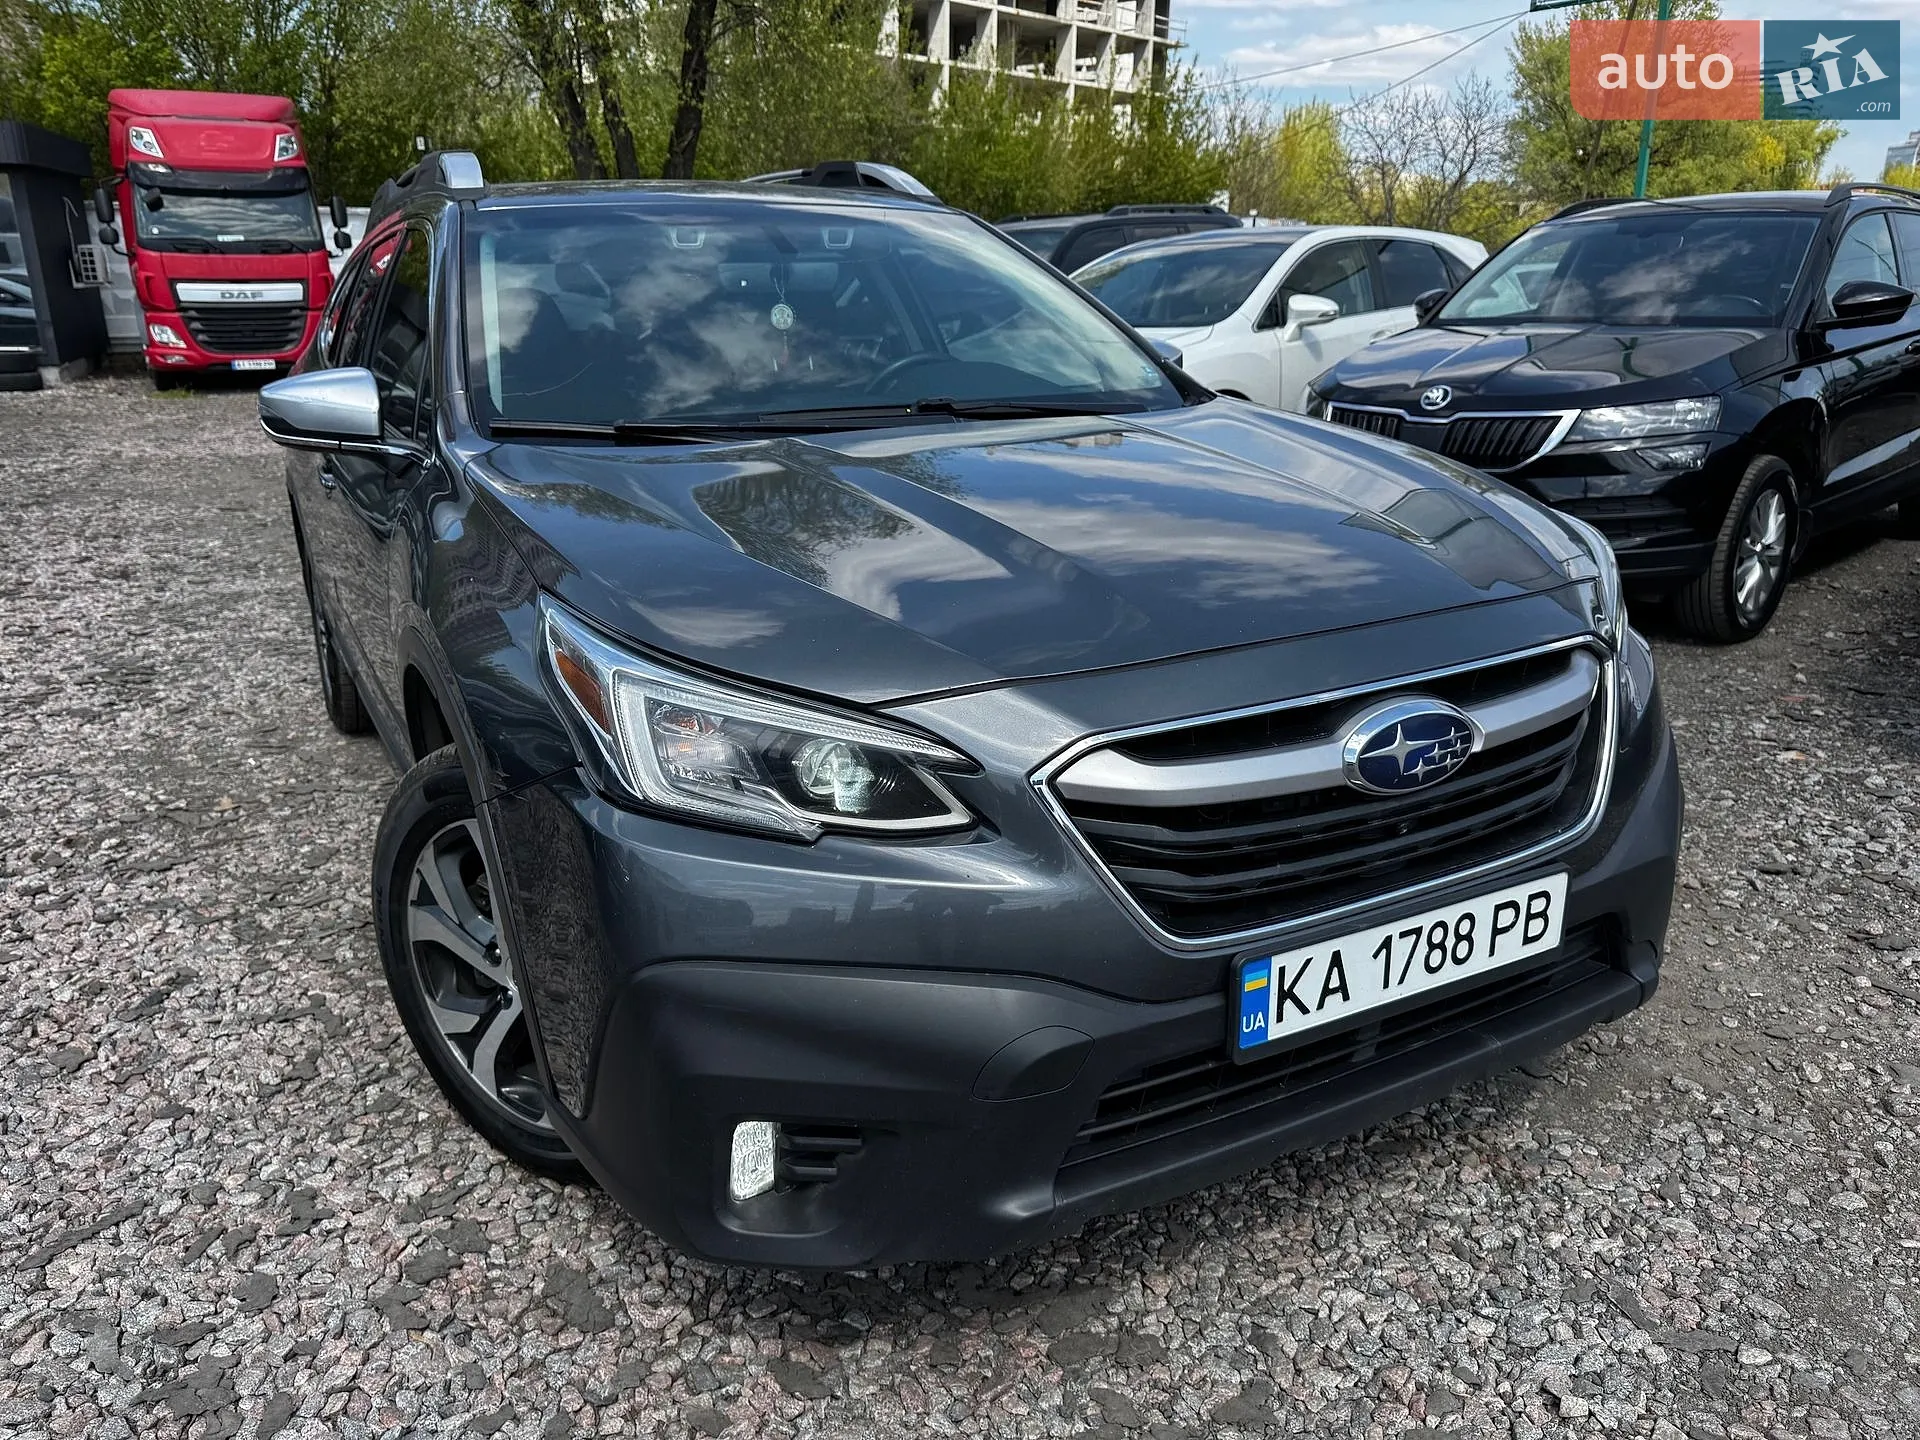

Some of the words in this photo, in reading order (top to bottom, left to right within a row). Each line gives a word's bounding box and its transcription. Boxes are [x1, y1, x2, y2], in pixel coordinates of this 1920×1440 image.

[220, 291, 263, 299] DAF
[1275, 949, 1350, 1023] KA
[1372, 912, 1476, 989] 1788
[1488, 889, 1552, 957] PB
[1242, 1011, 1265, 1033] UA
